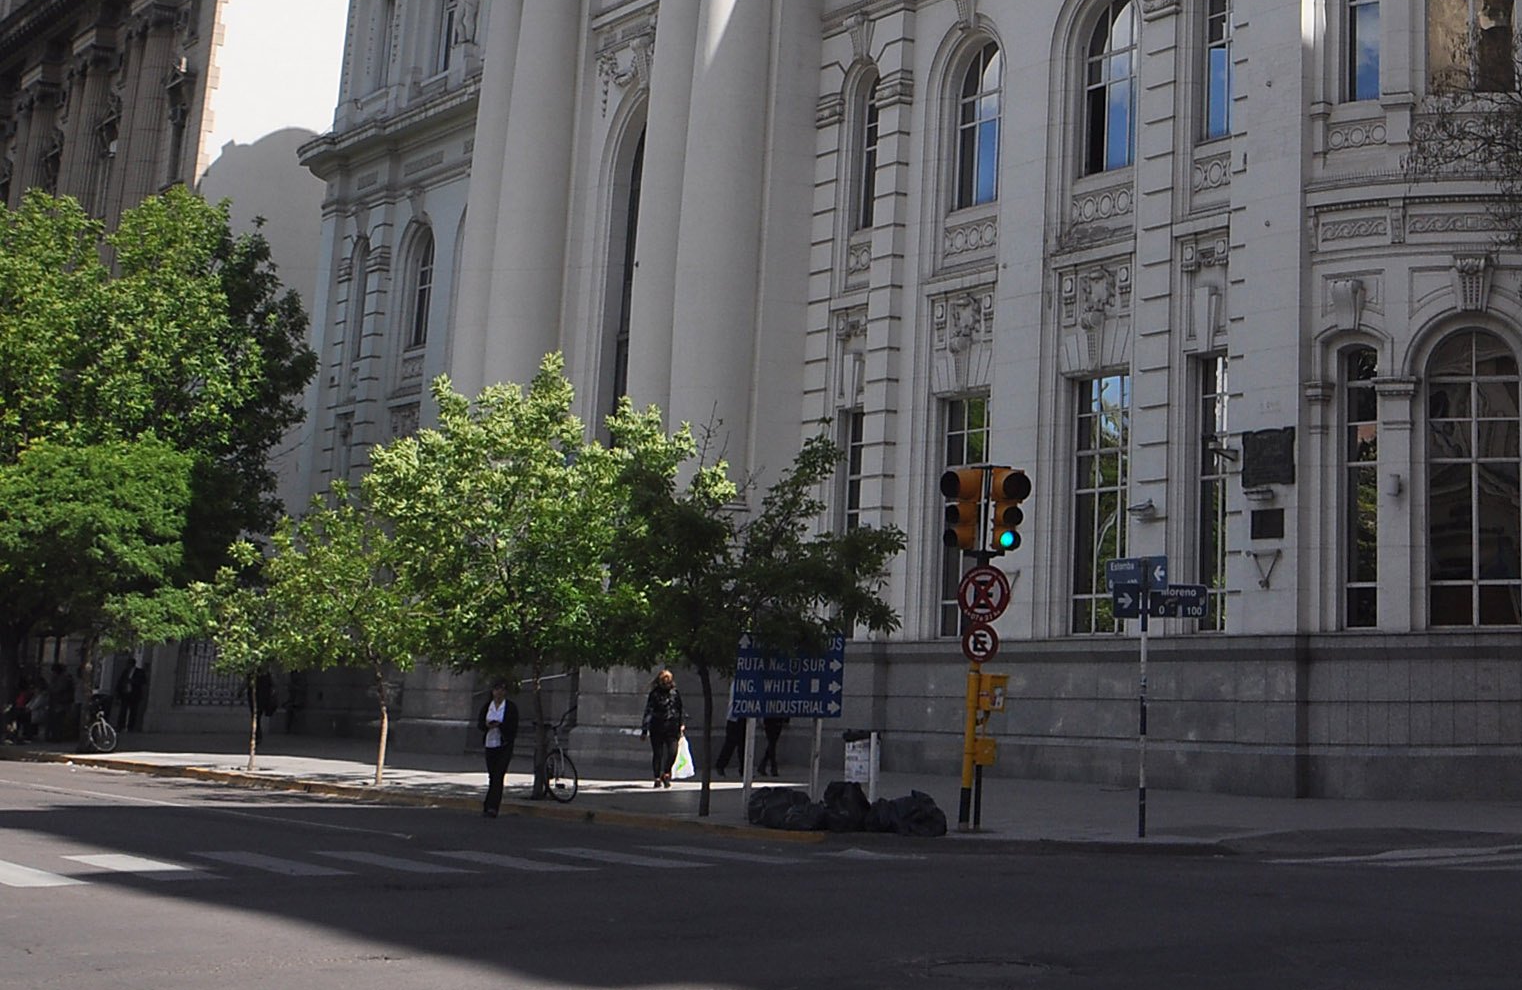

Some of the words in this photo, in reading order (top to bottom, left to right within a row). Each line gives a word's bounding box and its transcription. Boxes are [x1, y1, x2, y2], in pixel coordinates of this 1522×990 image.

[1158, 605, 1165, 615] 0
[1187, 606, 1203, 616] 100
[737, 657, 764, 671] RUTA
[802, 658, 826, 672] SUR
[735, 678, 757, 693] ING.
[763, 678, 800, 694] WHITE
[734, 699, 762, 713] ZONA
[765, 699, 824, 714] INDUSTRIAL
